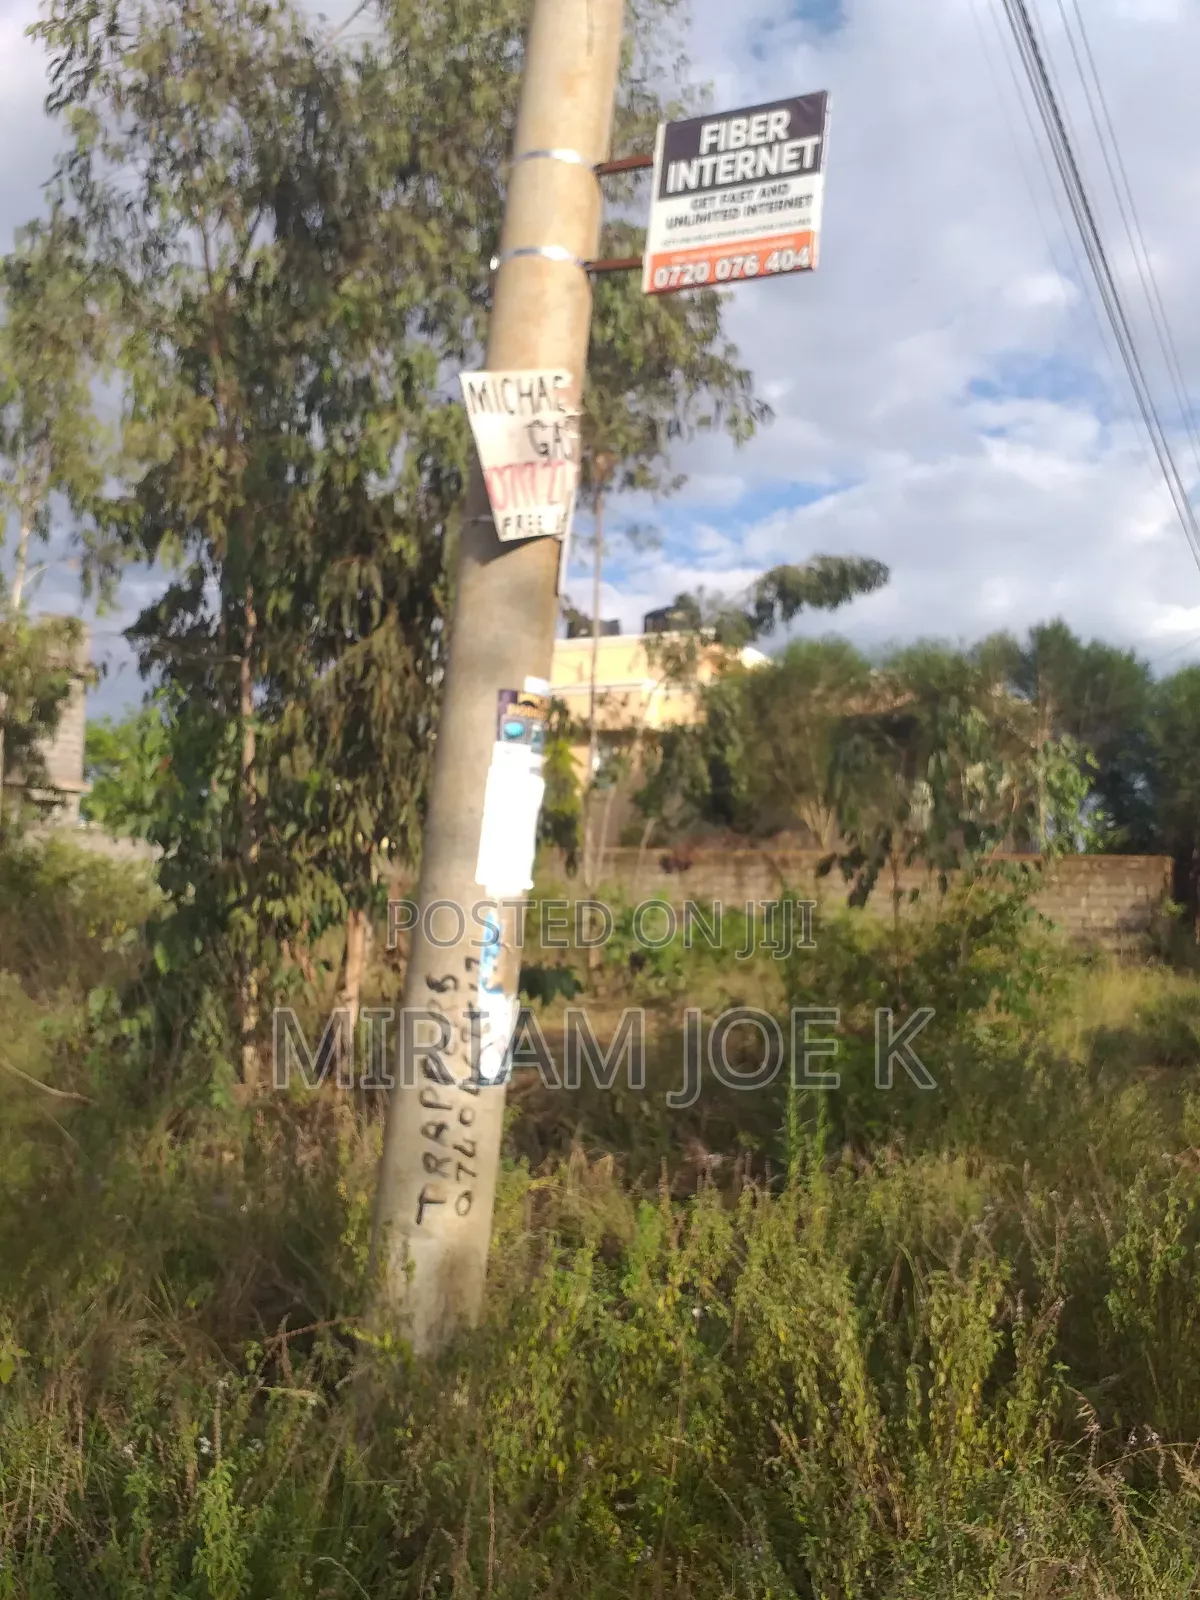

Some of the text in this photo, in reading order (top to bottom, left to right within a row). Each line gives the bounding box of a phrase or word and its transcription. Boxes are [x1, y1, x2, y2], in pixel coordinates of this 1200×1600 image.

[699, 110, 792, 156] FIBER
[666, 136, 822, 194] INTERNET
[665, 193, 814, 230] UNLIMITED INTERNET
[691, 182, 790, 211] GET FAST AND
[653, 261, 711, 289] 0720
[714, 253, 760, 279] 076
[764, 245, 811, 273] 404
